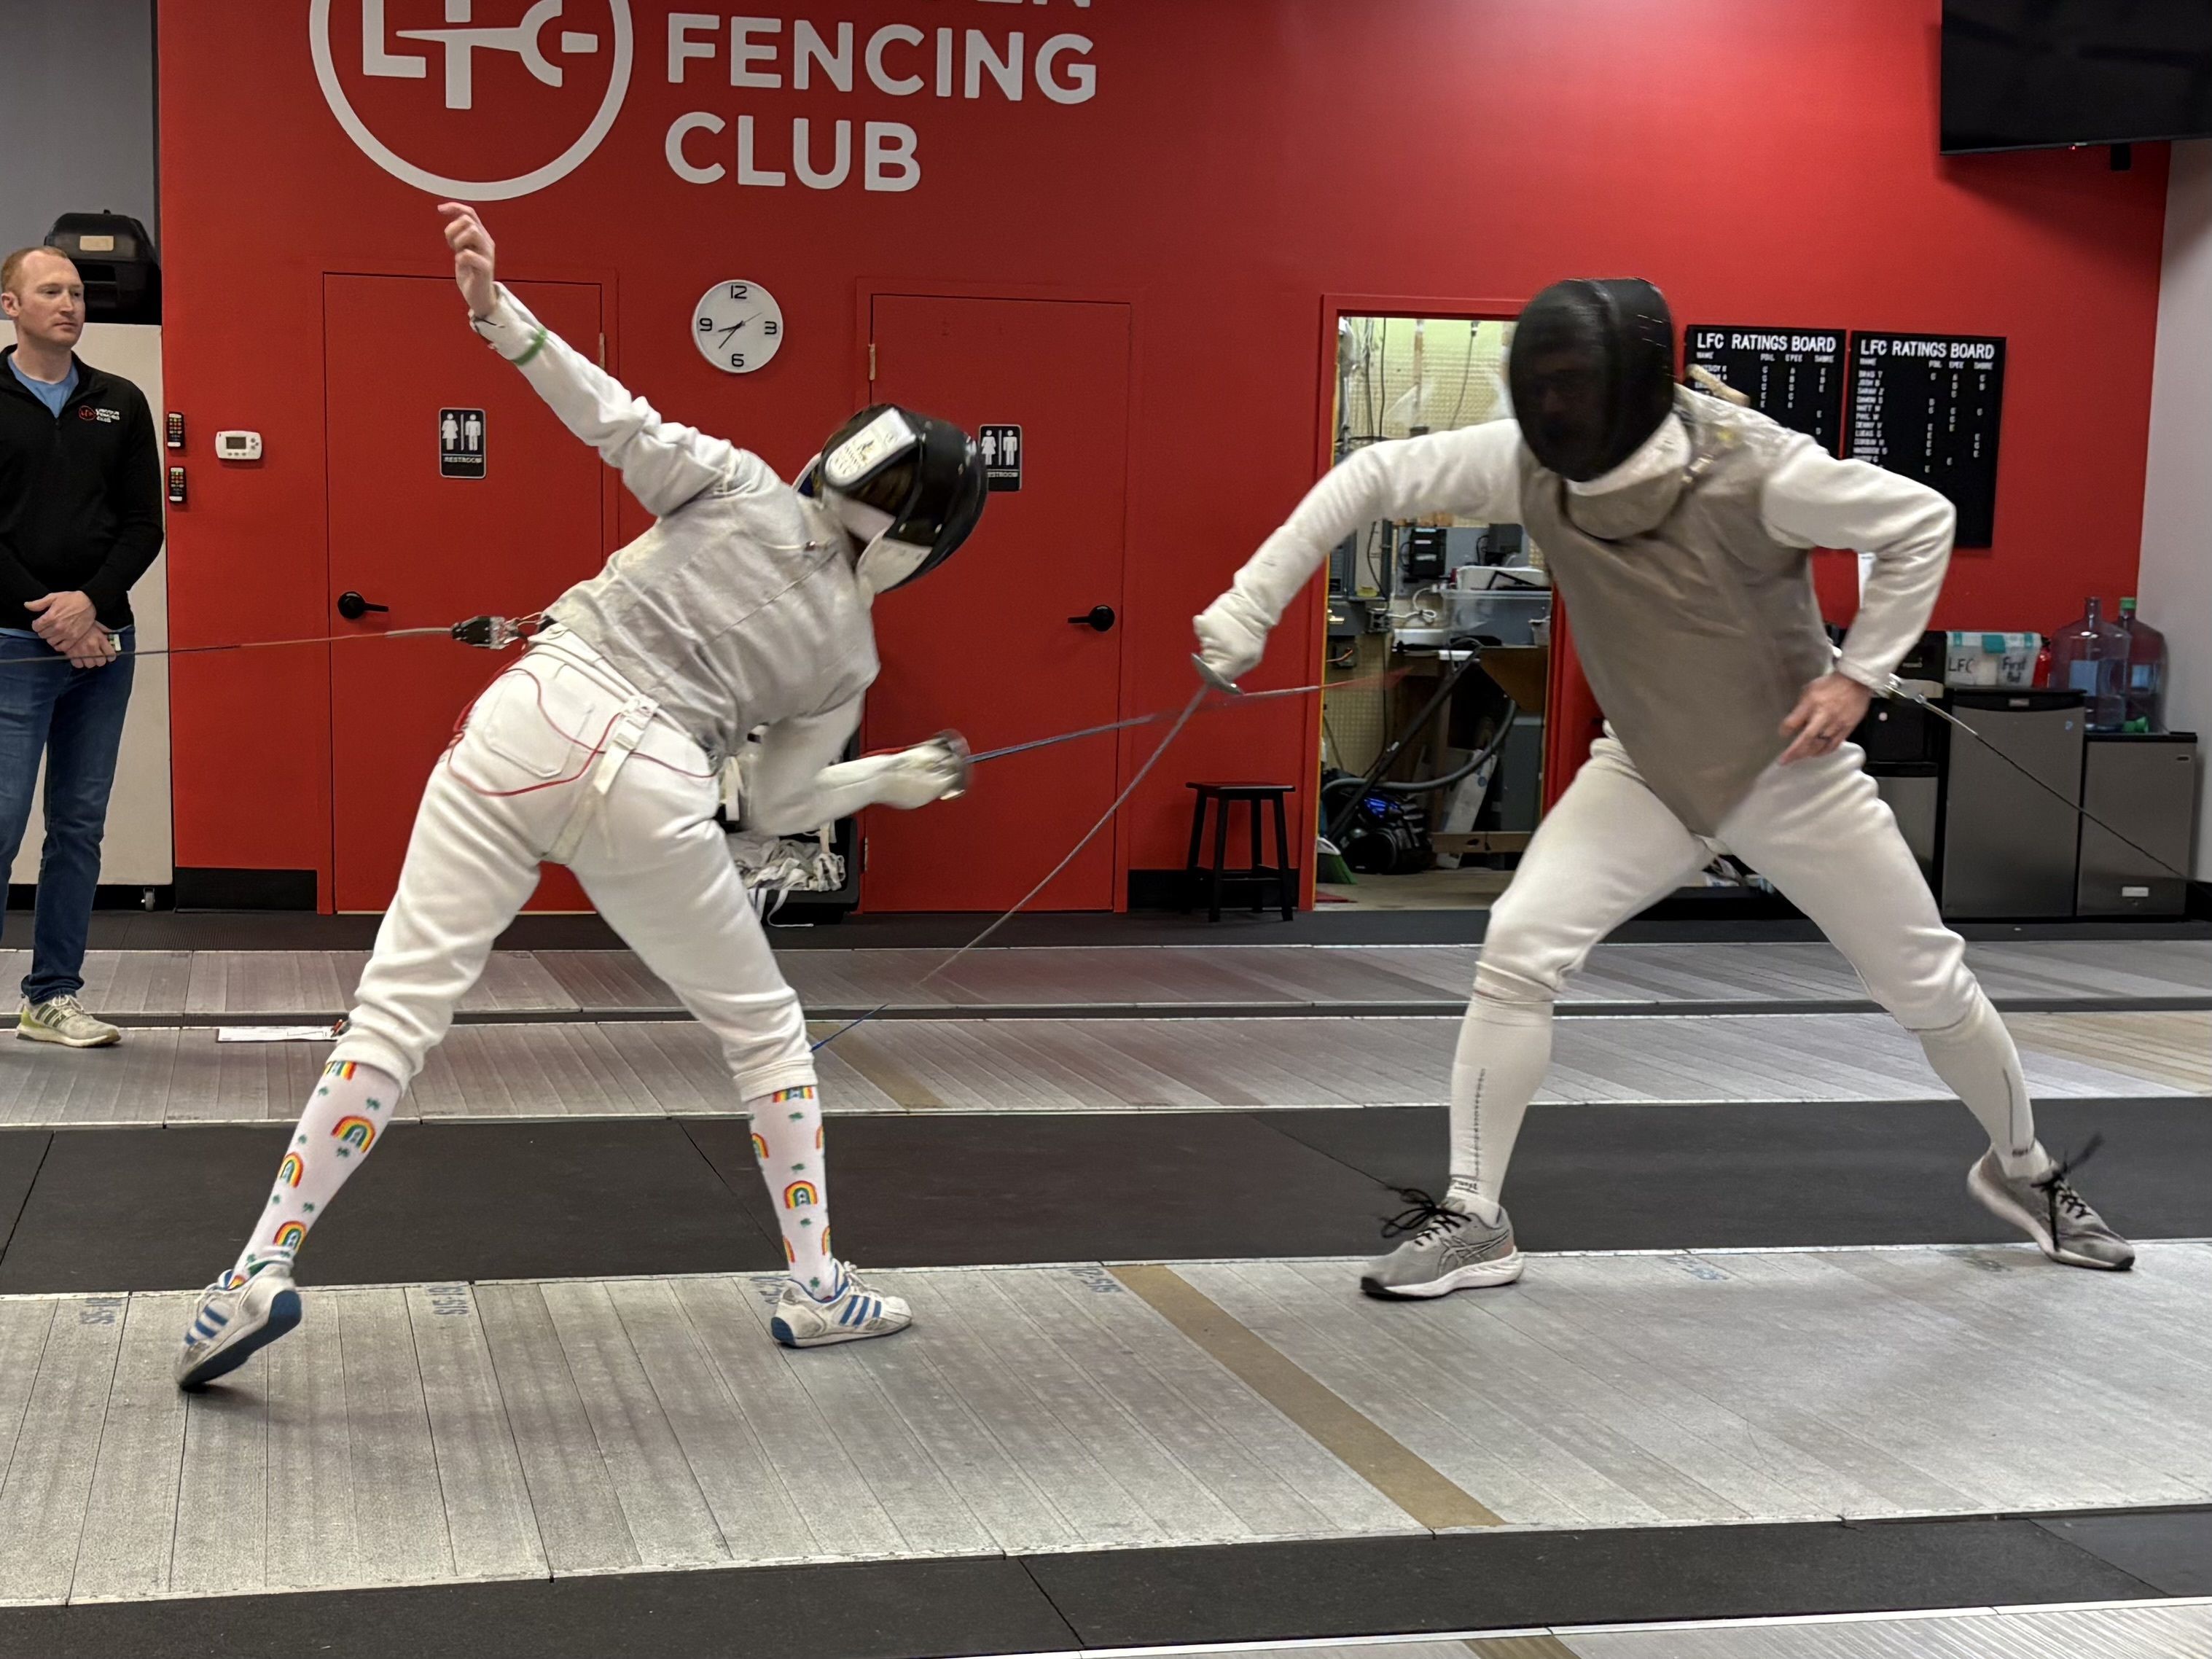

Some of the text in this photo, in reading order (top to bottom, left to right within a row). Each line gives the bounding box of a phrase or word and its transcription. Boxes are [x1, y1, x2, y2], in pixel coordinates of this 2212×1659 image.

[668, 12, 1096, 104] FENCING
[665, 112, 921, 192] CLUB
[730, 285, 747, 299] 12
[700, 318, 713, 332] 9
[765, 321, 777, 335] 3
[1697, 332, 1836, 353] LFC RATINGS BOARD
[1861, 339, 1995, 359] LFC RATINGS BOARD
[731, 354, 744, 367] 6
